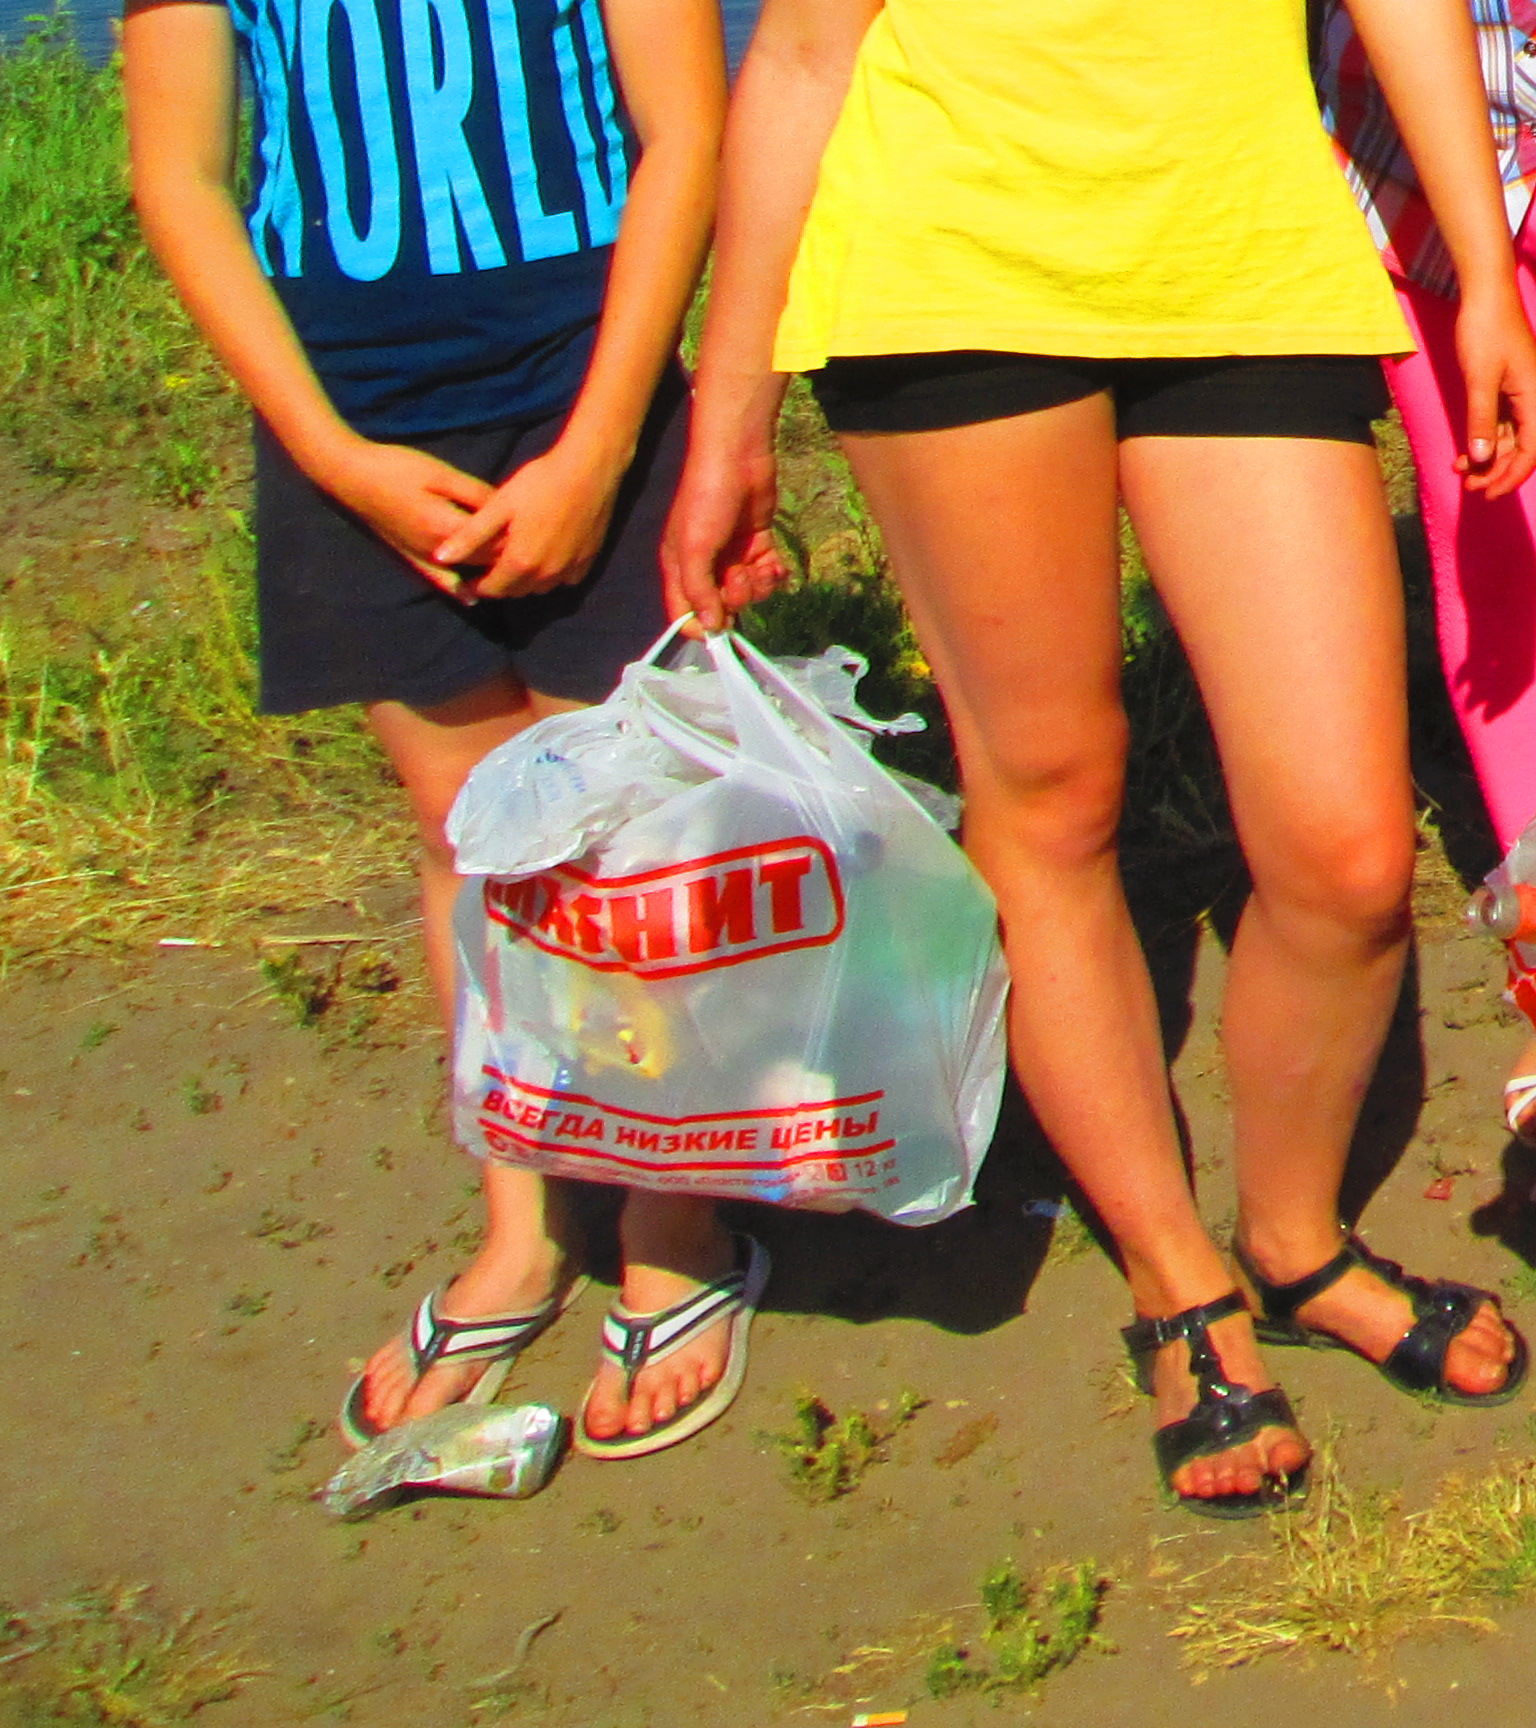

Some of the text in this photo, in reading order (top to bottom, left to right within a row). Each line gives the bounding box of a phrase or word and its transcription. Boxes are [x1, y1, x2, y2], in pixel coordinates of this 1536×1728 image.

[482, 1089, 879, 1155] ВСЕГДА НИЗКИЕ ЦЕНЫ
